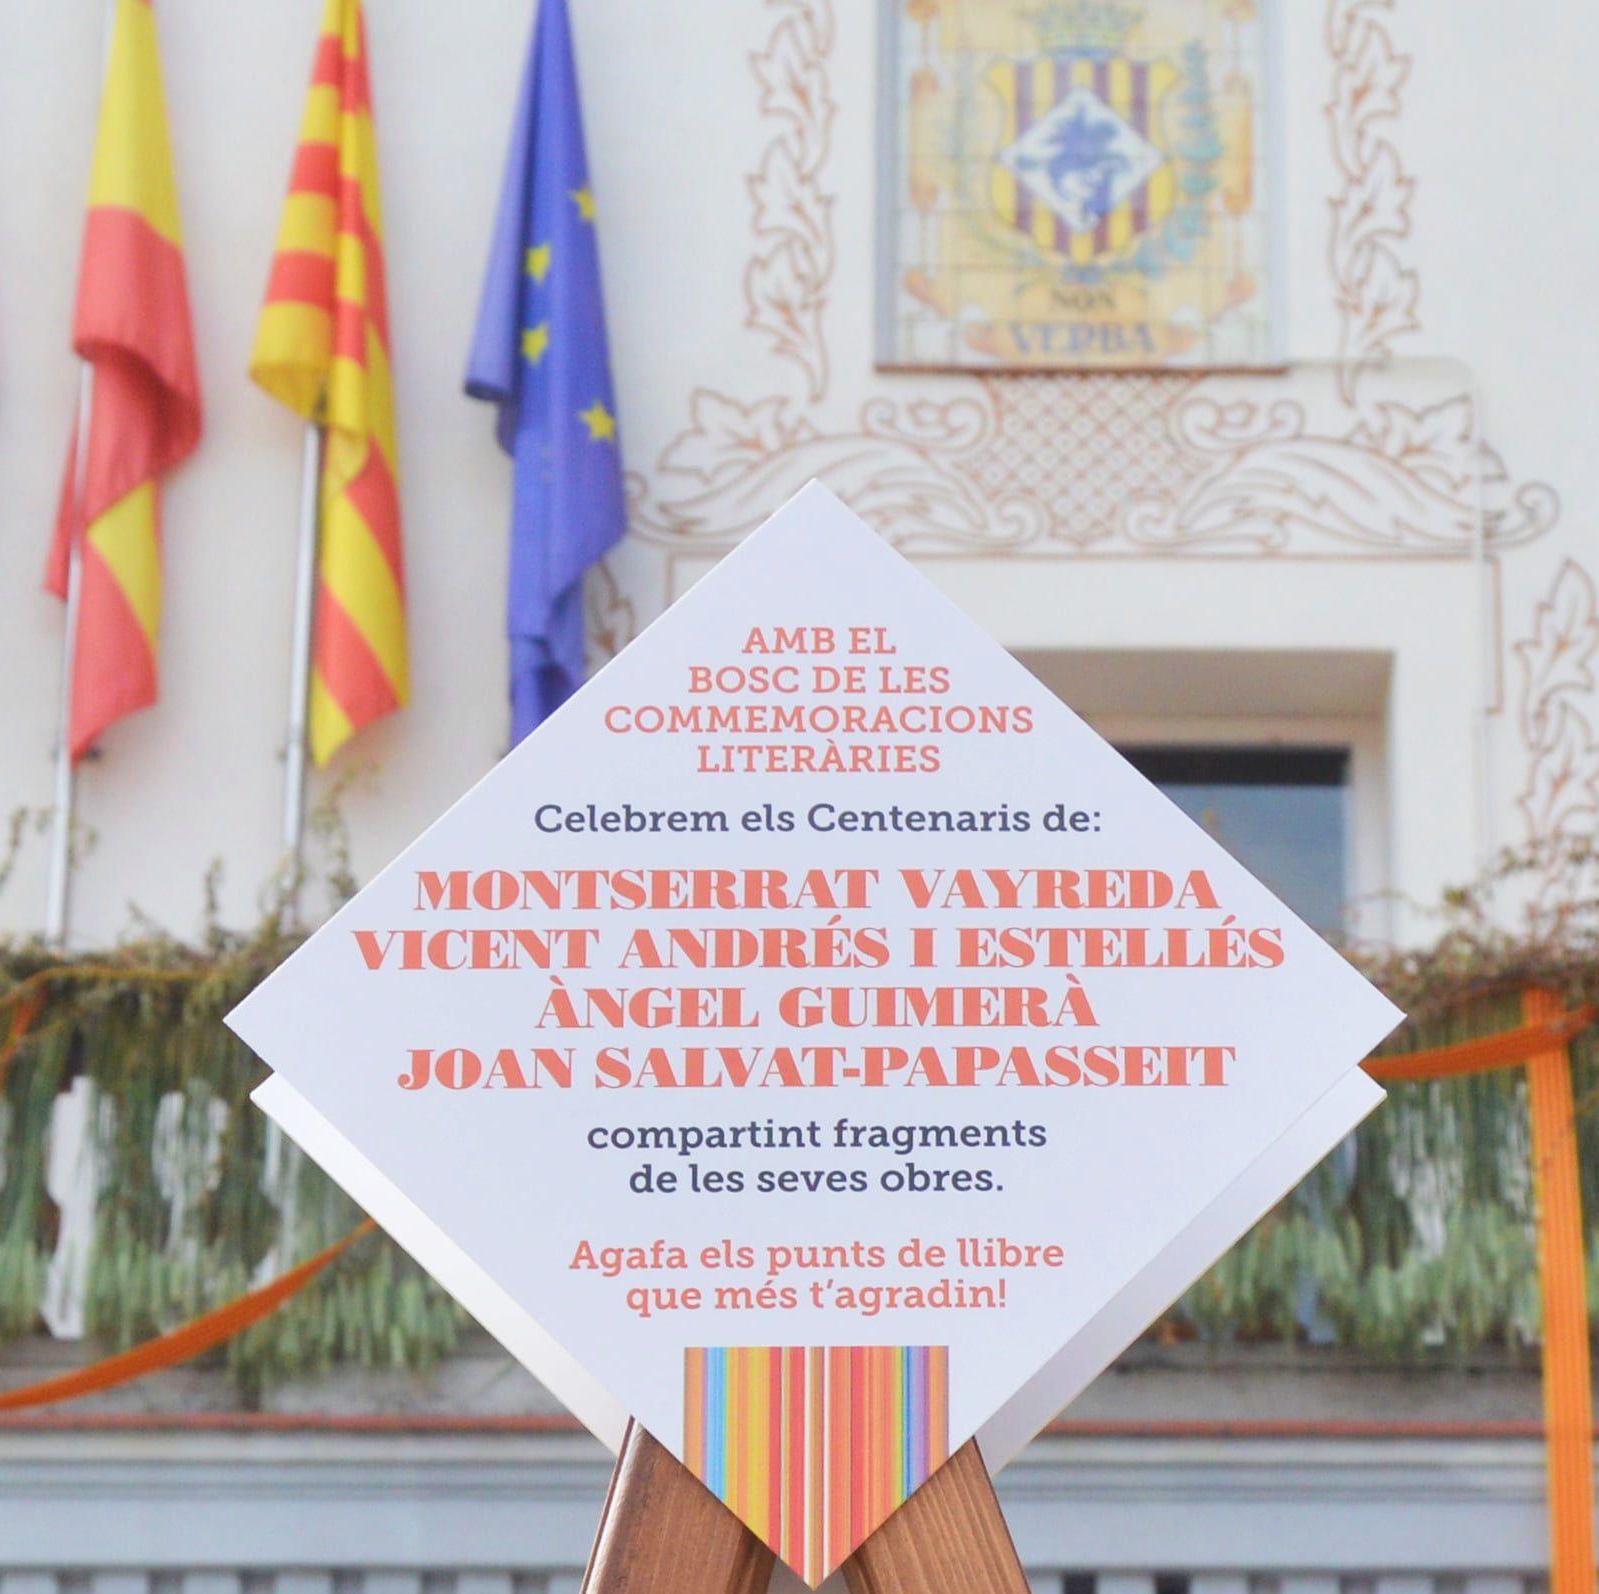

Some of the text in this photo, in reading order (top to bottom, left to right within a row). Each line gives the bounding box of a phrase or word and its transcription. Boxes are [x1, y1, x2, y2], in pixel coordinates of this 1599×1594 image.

[739, 627, 897, 656] AMB EL
[688, 665, 951, 695] BOSC DE LES
[603, 704, 1034, 735] COMMEMORACIONS
[697, 739, 941, 773] LITERÀRIES
[534, 803, 1101, 833] Celebrem els Centenaris de:
[414, 868, 1221, 911] MONTSERRAT VAYREDA
[352, 913, 1285, 970] VICENT ANDRÉS I ESTELLÉS
[534, 973, 1100, 1030] ÀNGEL GUIMERÀ
[397, 1043, 1236, 1092] JOAN SALVAT-PAPASSEIT
[586, 1118, 1049, 1154] compartint fragments
[628, 1162, 1004, 1195] de les seves obres.
[568, 1235, 1065, 1276] Agafa els punts de llibre
[625, 1277, 1006, 1318] que més t’agradin!
